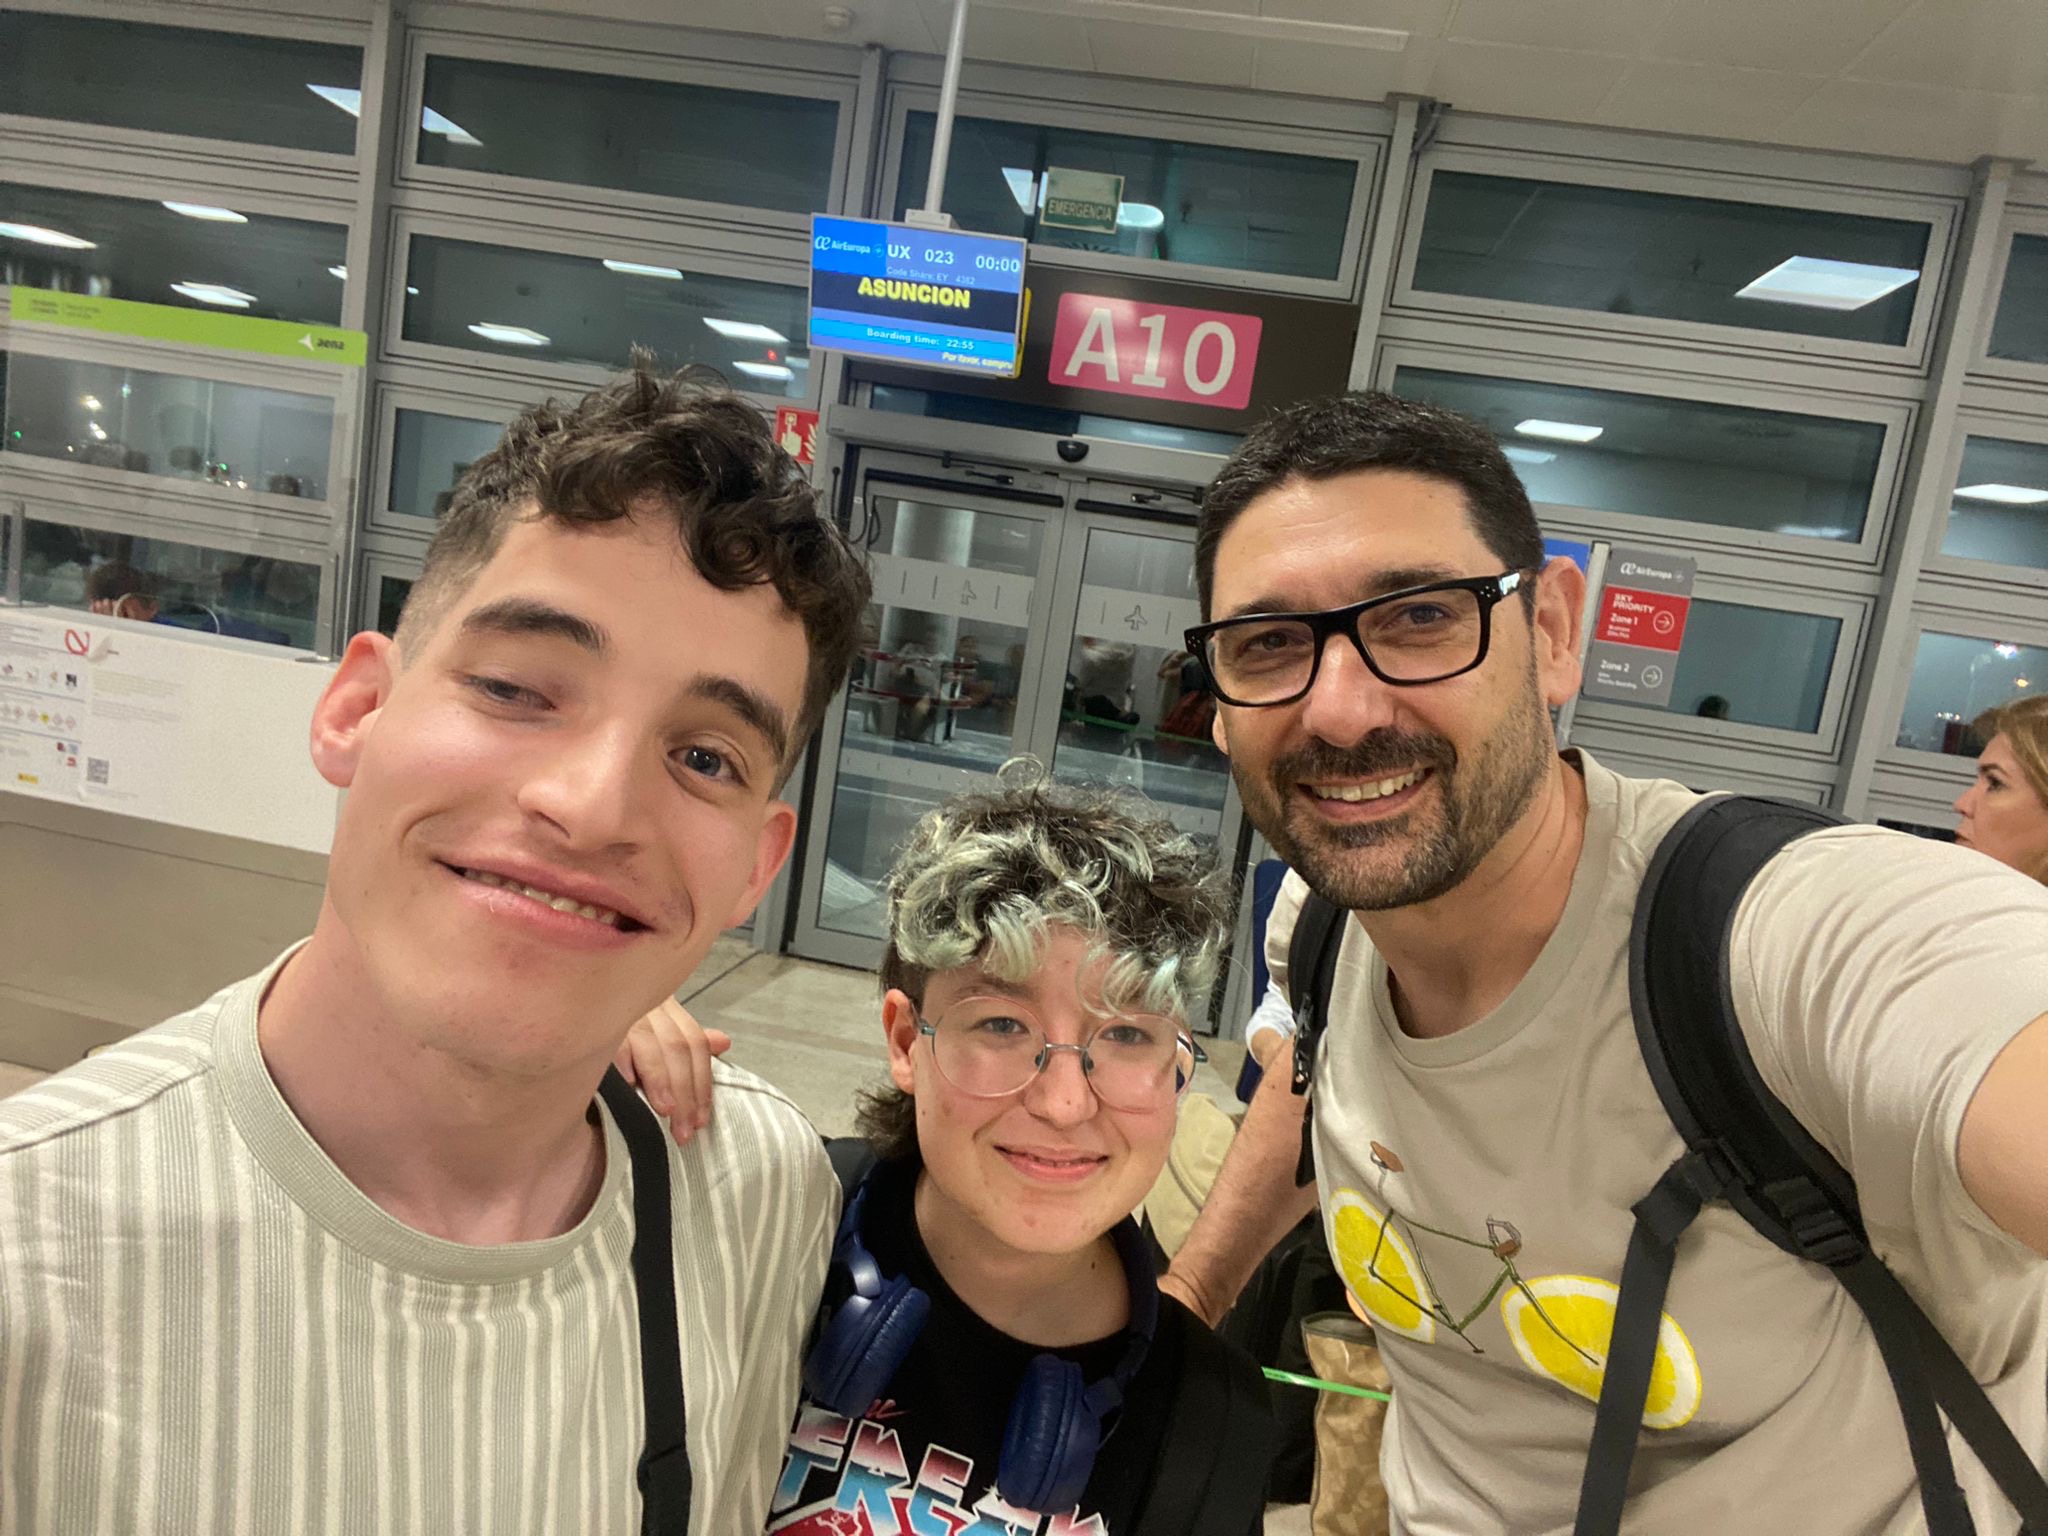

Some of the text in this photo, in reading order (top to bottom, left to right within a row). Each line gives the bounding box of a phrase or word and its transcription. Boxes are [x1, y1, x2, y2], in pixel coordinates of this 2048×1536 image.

[1048, 199, 1112, 221] EMERGENCIA
[887, 244, 1020, 273] UX 023 00:00
[857, 277, 971, 309] ASUNCION
[316, 337, 345, 350] aena
[867, 327, 975, 350] Boarding time: 22:55
[1064, 307, 1236, 396] A10
[1613, 600, 1655, 614] PRIORITY
[1610, 612, 1633, 625] Zone
[1600, 659, 1630, 673] Zone 2
[771, 1404, 1109, 1536] FRE
